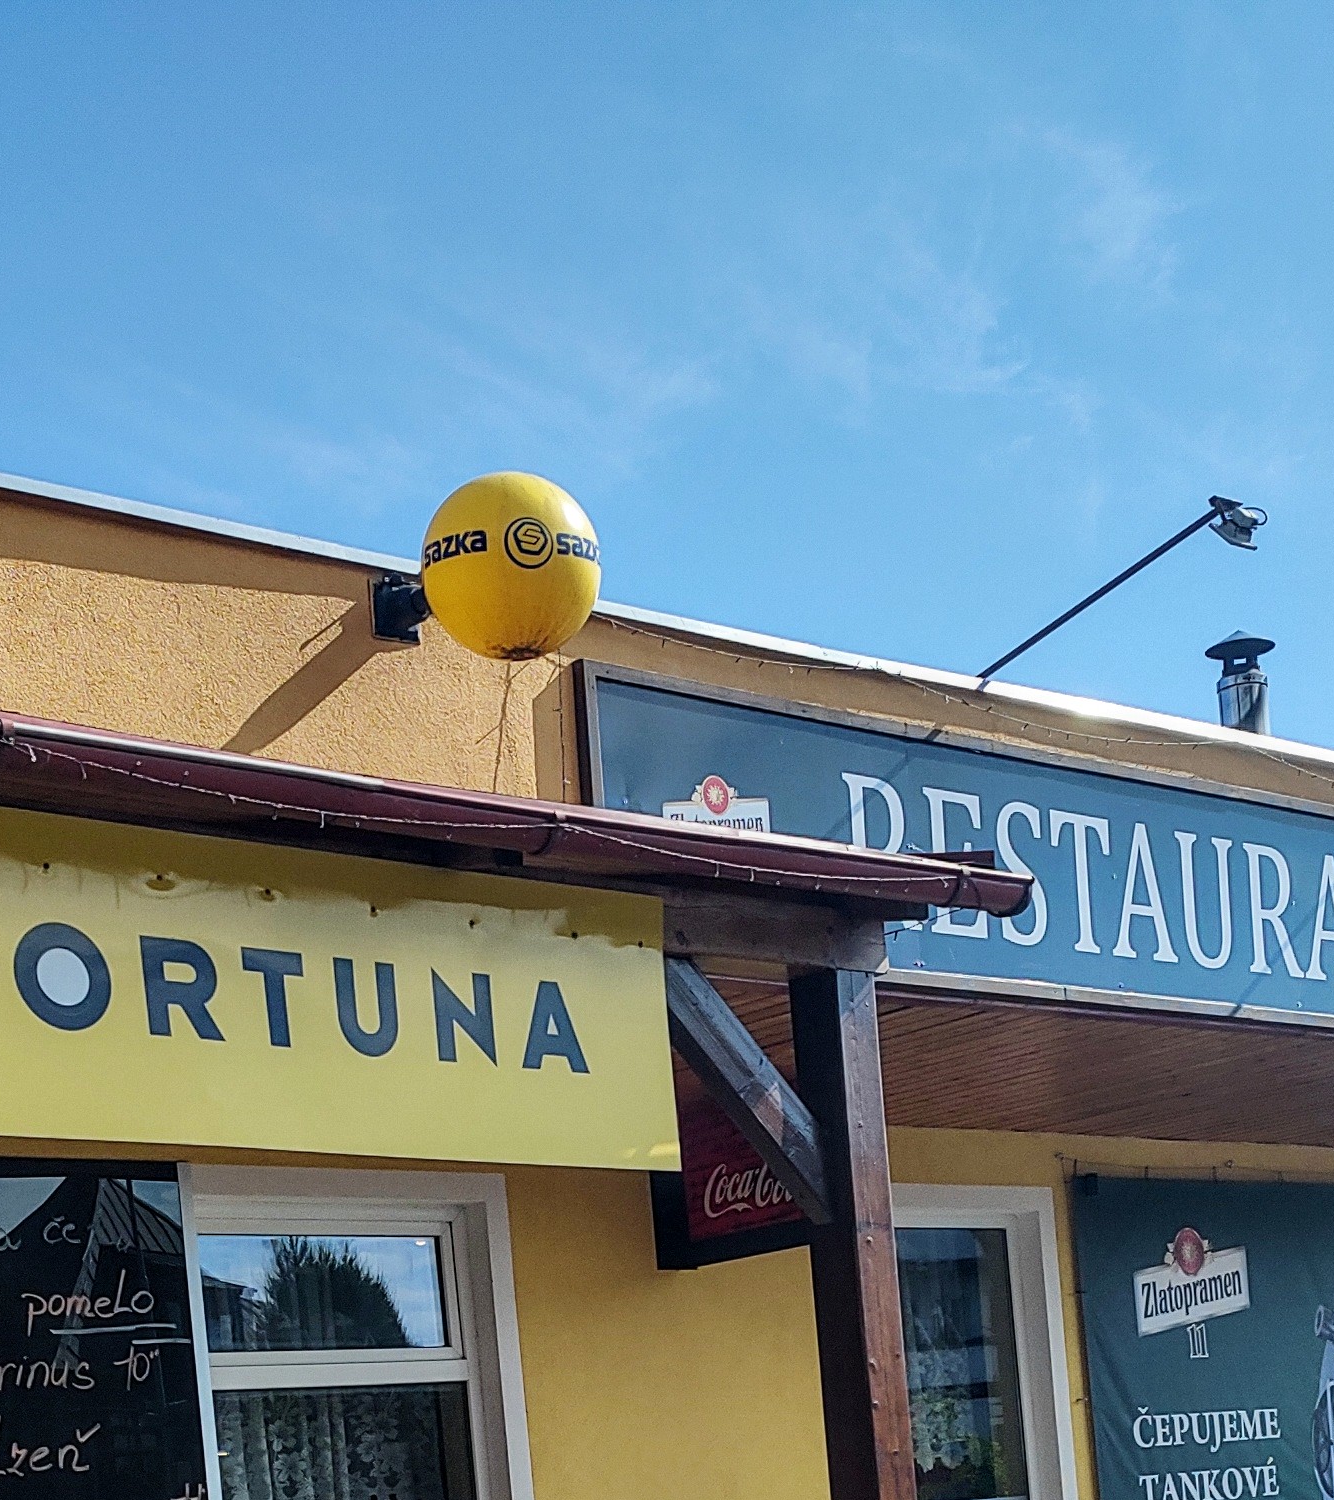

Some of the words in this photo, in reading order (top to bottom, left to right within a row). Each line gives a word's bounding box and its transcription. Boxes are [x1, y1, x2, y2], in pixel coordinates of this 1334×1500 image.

[1140, 1269, 1243, 1320] Zlatopramen
[1186, 1322, 1209, 1359] 11
[1133, 1406, 1281, 1452] ČEPUJEME
